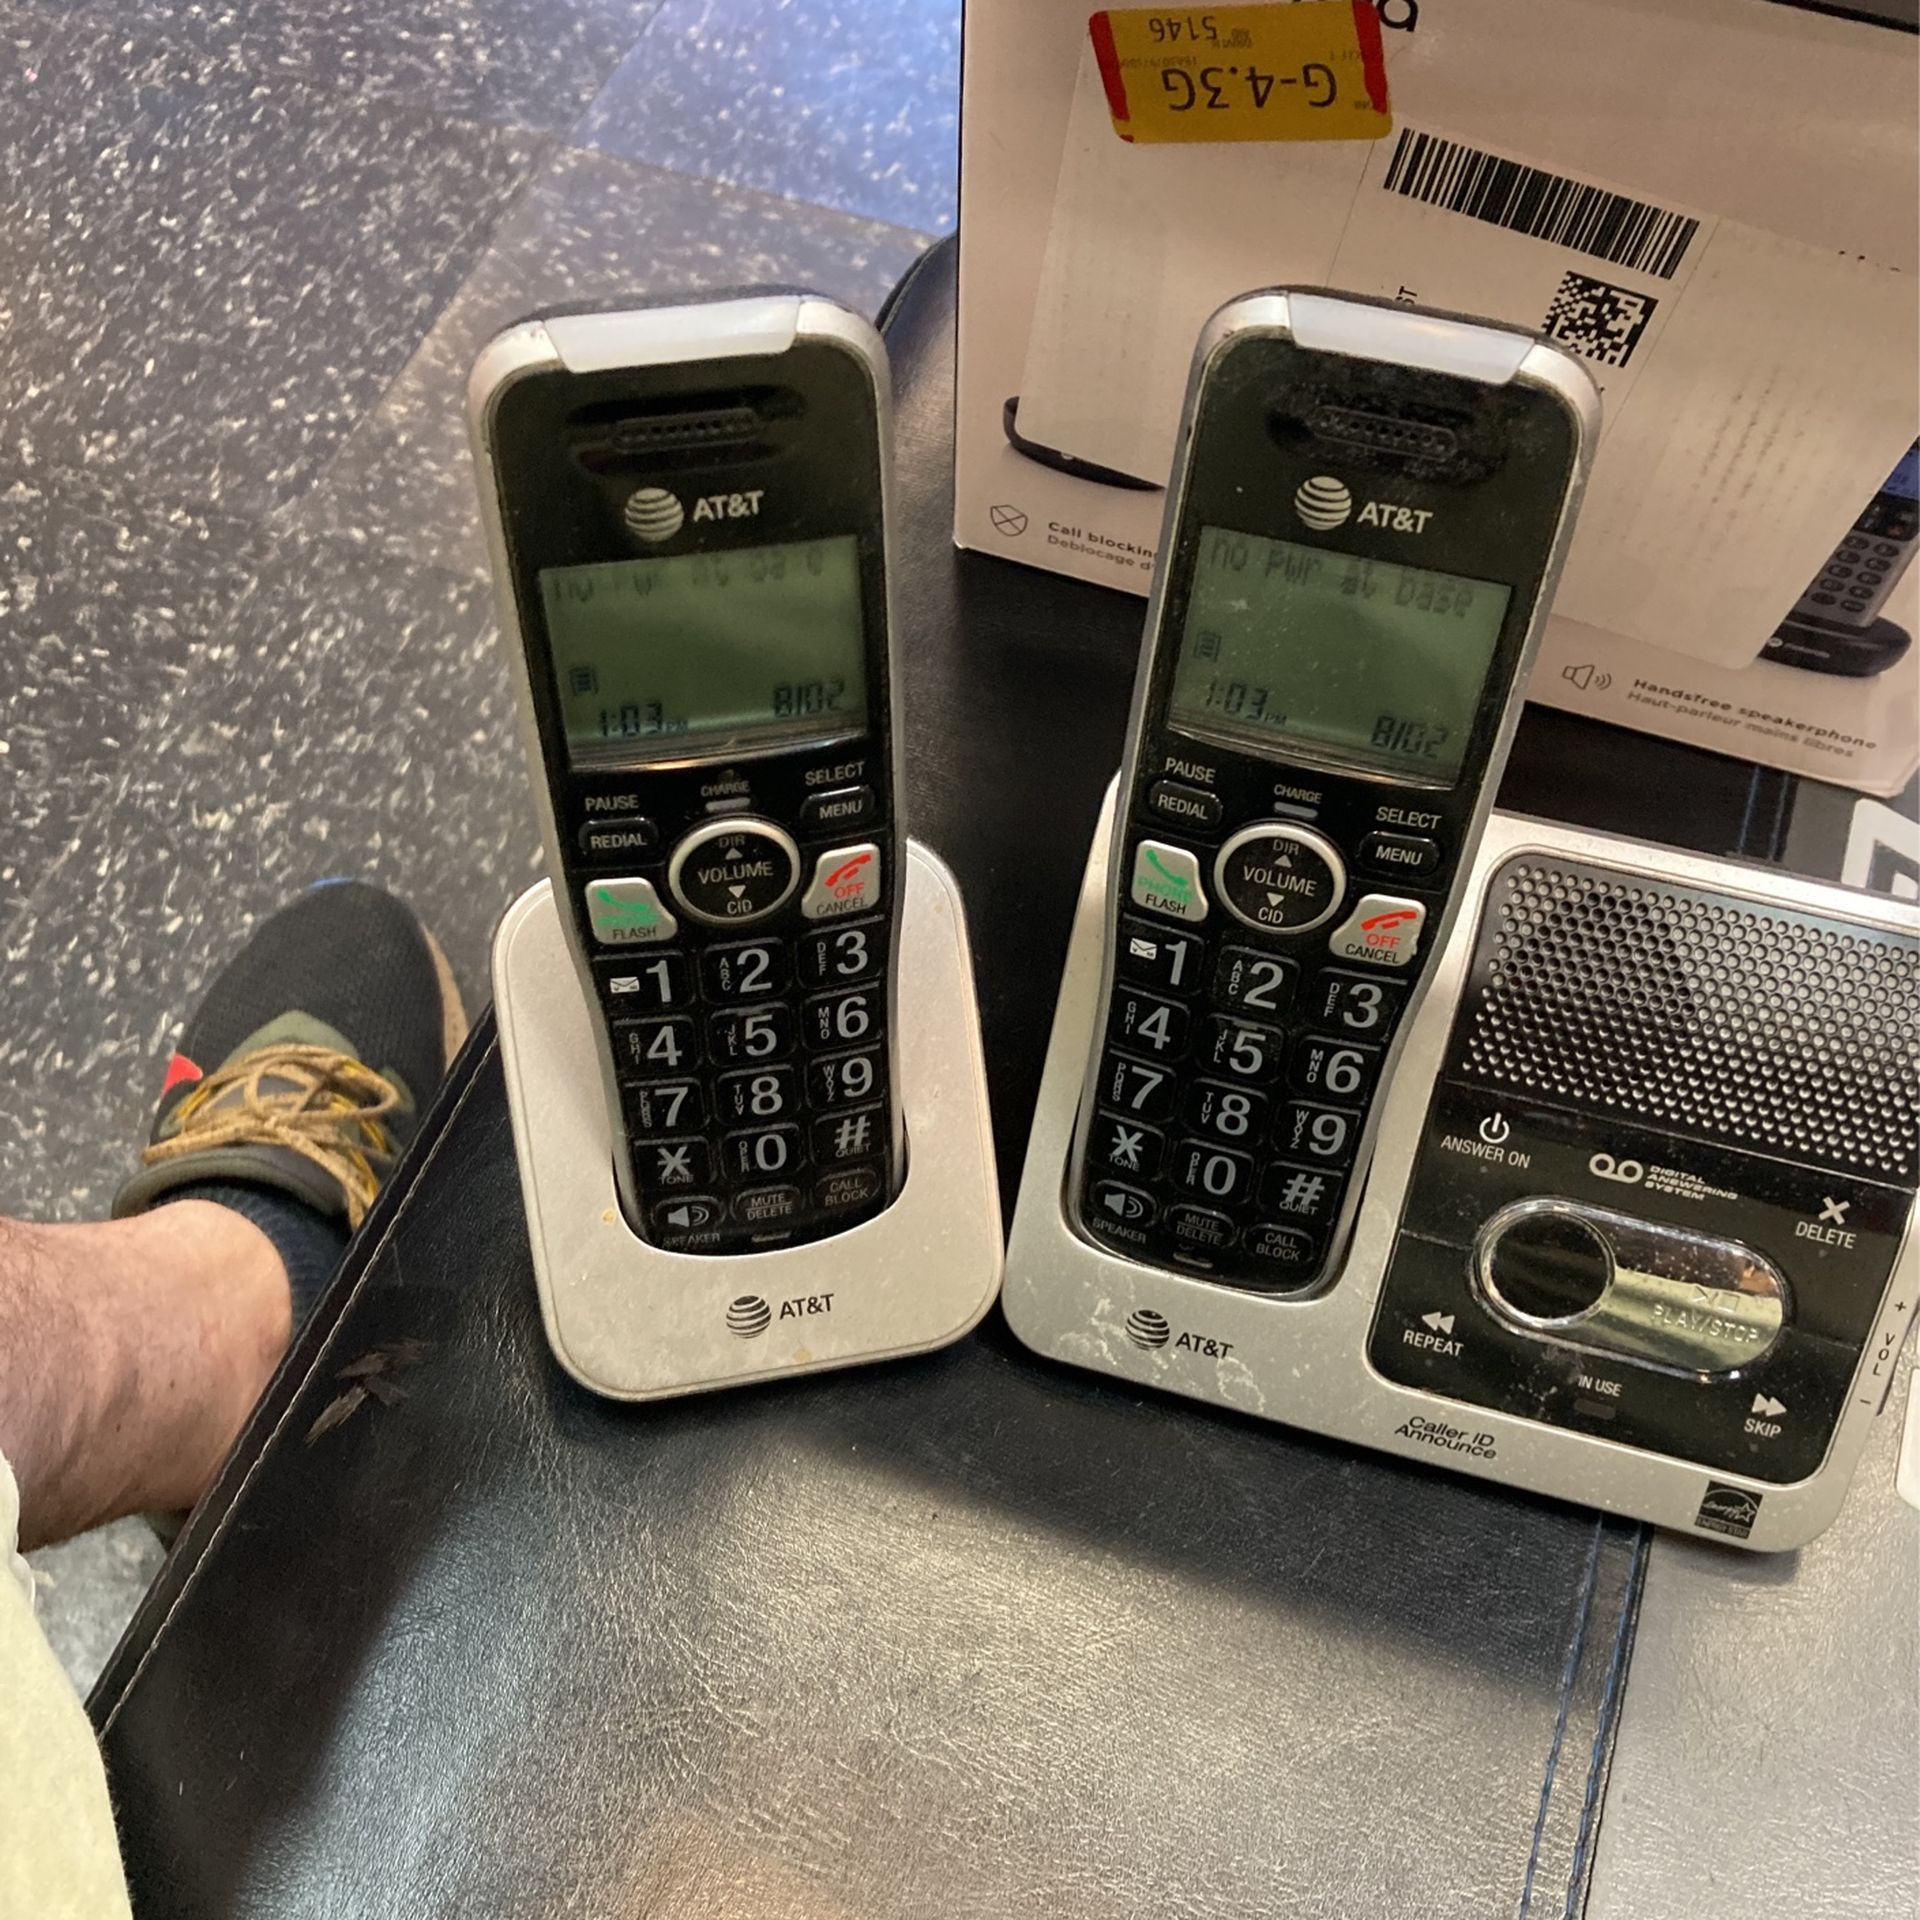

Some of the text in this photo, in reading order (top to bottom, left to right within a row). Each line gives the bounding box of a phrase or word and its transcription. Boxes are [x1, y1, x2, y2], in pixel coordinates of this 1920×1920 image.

[1149, 16, 1217, 43] 5146
[1161, 63, 1337, 112] G-4.3G
[693, 490, 764, 522] AT&T
[1357, 501, 1434, 534] AT&T
[1048, 521, 1081, 538] Call
[1205, 679, 1267, 720] 1:03
[1627, 691, 1742, 727] Haut-parleur
[600, 702, 664, 737] 1:03
[1633, 678, 1877, 750] Handsfree speakerphone
[805, 762, 865, 786] SELECT
[1165, 757, 1216, 784] PAUSE
[585, 795, 639, 812] PAUSE
[1158, 794, 1208, 820] REDIAL
[1273, 784, 1322, 805] CHARGE
[819, 800, 862, 819] MENU
[1376, 806, 1442, 830] SELECT
[591, 833, 647, 849] REDIAL
[719, 834, 745, 847] DIR
[1272, 838, 1300, 855] DIR
[1376, 845, 1423, 866] MENU
[698, 861, 773, 885] VOLUME
[1243, 866, 1317, 897] VOLUME
[834, 882, 864, 899] OFF
[1145, 893, 1187, 915] FLASH
[727, 900, 752, 914] CID
[816, 898, 868, 916] CANCEL
[1257, 907, 1284, 924] CID
[613, 926, 656, 940] FLASH
[1366, 933, 1400, 949] OFF
[817, 931, 868, 976] DEF 3
[1165, 940, 1188, 986] 1
[1345, 943, 1400, 965] CANCEL
[645, 960, 671, 1003] 1
[719, 949, 772, 993] ABC 2
[1228, 960, 1284, 1010] ABC 2
[818, 996, 869, 1040] MNO 6
[1323, 982, 1383, 1029] DEF 3
[727, 1014, 777, 1056] JKL 5
[1125, 1001, 1171, 1050] GHI 4
[629, 1025, 683, 1066] GHI 4
[1213, 1029, 1267, 1074] JKL 5
[841, 1057, 873, 1097] 9
[1306, 1049, 1365, 1094] MNO 6
[733, 1076, 783, 1115] TUV 8
[1130, 1065, 1164, 1110] 7
[654, 1087, 688, 1127] 7
[1200, 1091, 1251, 1136] TUV 8
[834, 1115, 871, 1150] #
[1308, 1114, 1347, 1156] 9
[755, 1134, 787, 1171] 0
[1440, 1135, 1531, 1169] ANSWER ON
[829, 1179, 861, 1193] CALL
[1203, 1156, 1236, 1195] 0
[1650, 1165, 1705, 1184] DIGITAL
[751, 1193, 785, 1207] MUTE
[824, 1189, 869, 1207] BLOCK
[1282, 1173, 1325, 1208] #
[1644, 1181, 1705, 1200] SYSTEM
[747, 1205, 792, 1221] DELETE
[1185, 1212, 1220, 1231] MUTE
[1278, 1201, 1318, 1216] QUIET
[1092, 1217, 1147, 1244] SPEAKER
[1176, 1224, 1222, 1246] DELETE
[1264, 1231, 1298, 1249] CALL
[1795, 1220, 1857, 1249] DELETE
[1255, 1242, 1300, 1262] BLOCK
[779, 1293, 834, 1320] AT&T
[1651, 1304, 1758, 1343] PLAY/STOP
[1175, 1332, 1234, 1359] AT&T
[1403, 1329, 1464, 1357] REPEAT
[1872, 1332, 1896, 1376] VOL
[1577, 1374, 1622, 1397] IN USE
[1394, 1424, 1496, 1459] Announce
[1409, 1416, 1495, 1447] Caller ID
[1744, 1418, 1782, 1438] SKIP
